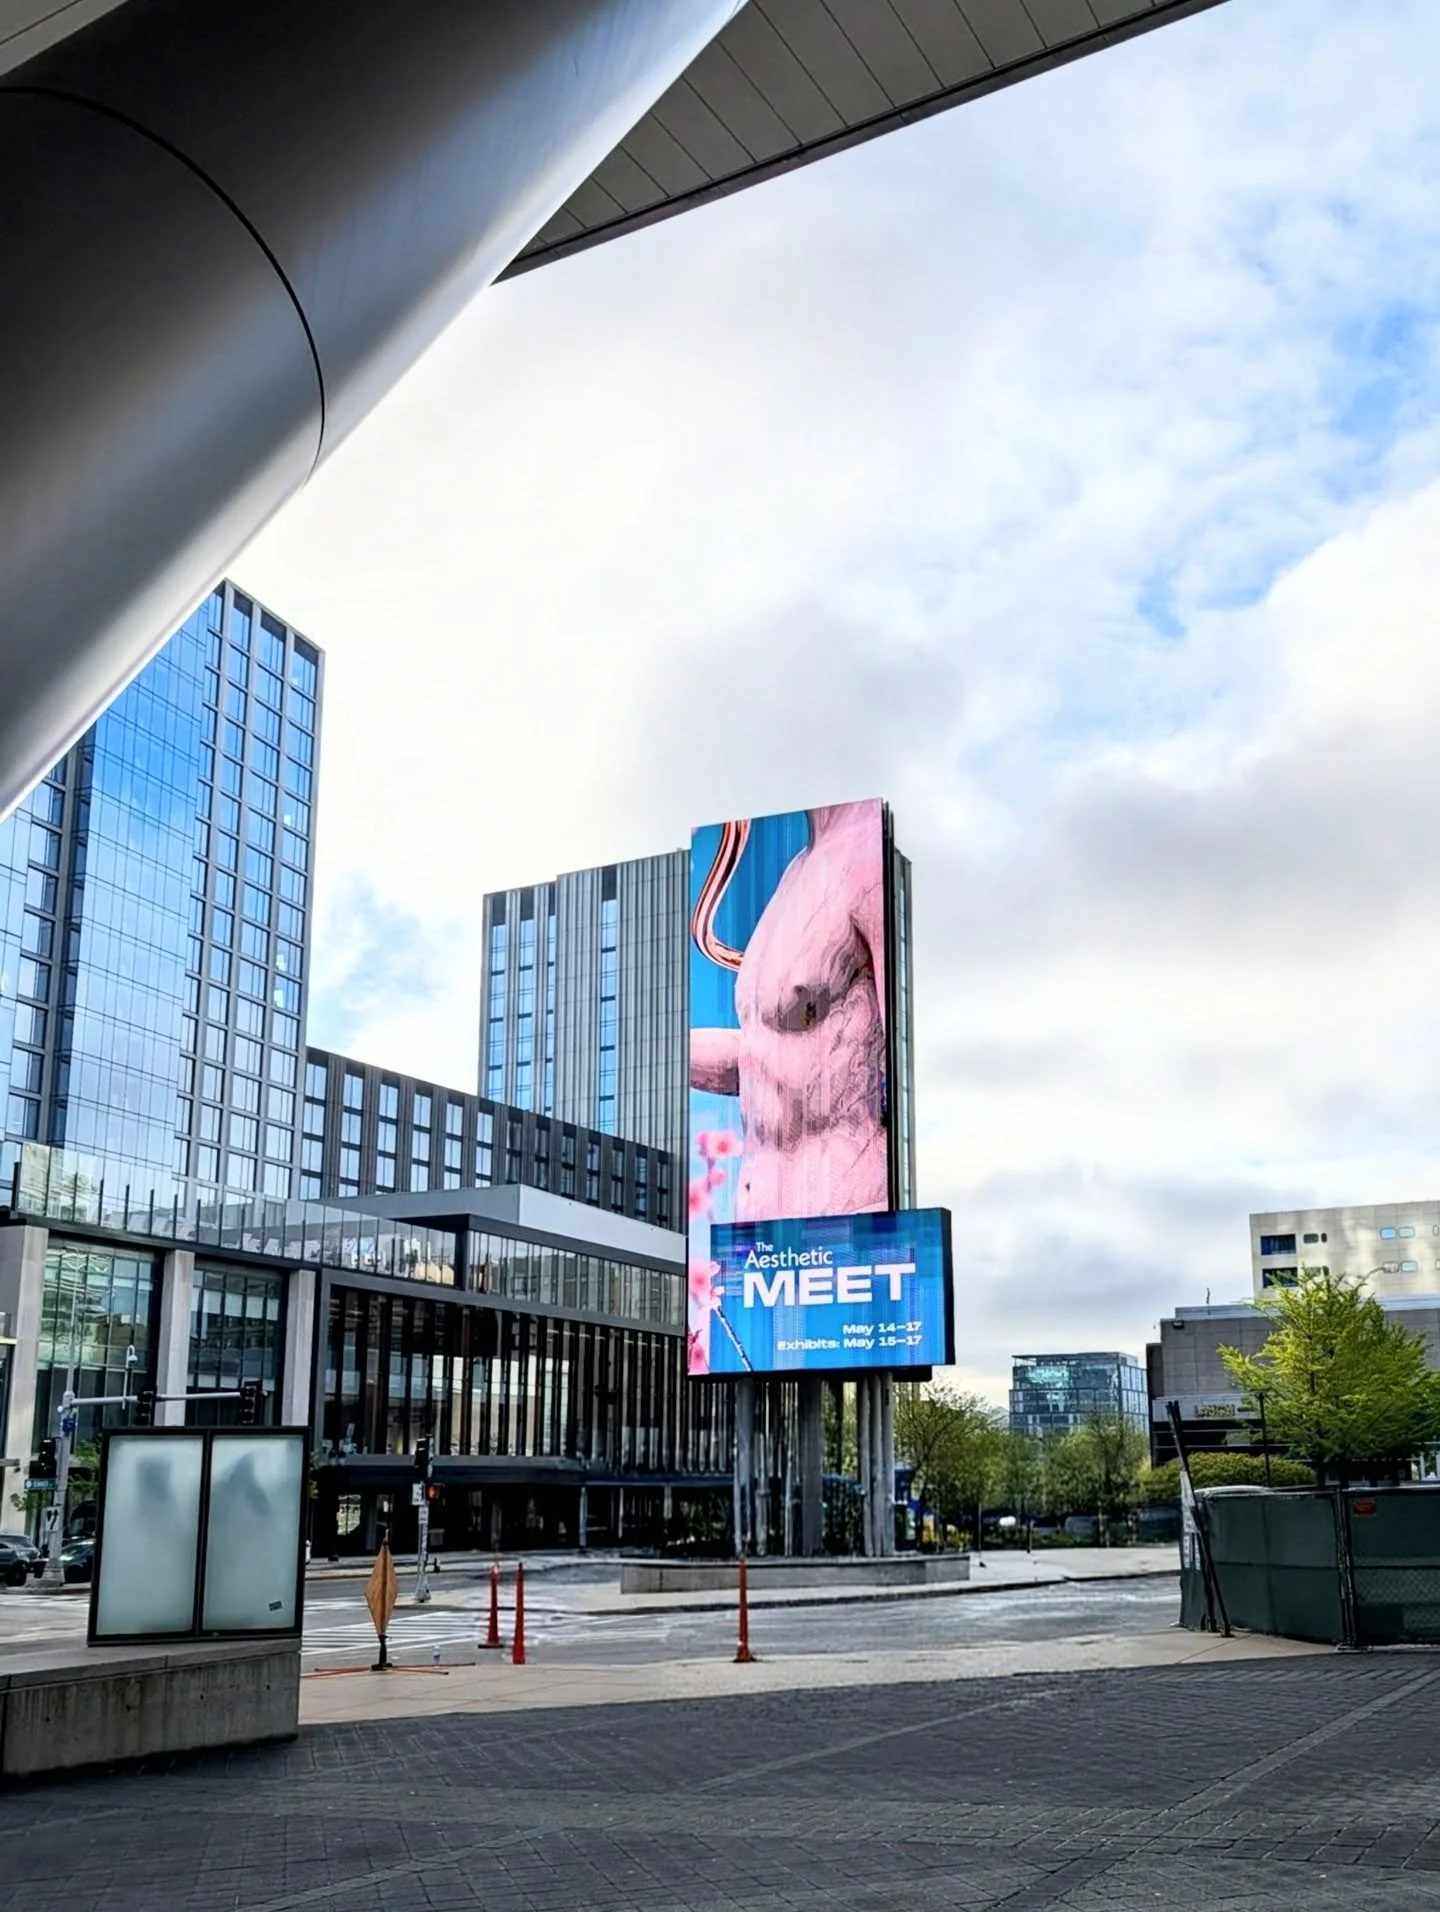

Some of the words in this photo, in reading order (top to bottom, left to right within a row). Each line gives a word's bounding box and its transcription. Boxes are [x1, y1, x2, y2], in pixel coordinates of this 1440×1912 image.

[755, 1241, 774, 1253] The
[744, 1246, 833, 1269] Aesthetic
[743, 1263, 916, 1308] MEET
[842, 1323, 875, 1336] May
[777, 1339, 840, 1351] Exhibits:
[843, 1337, 875, 1350] May
